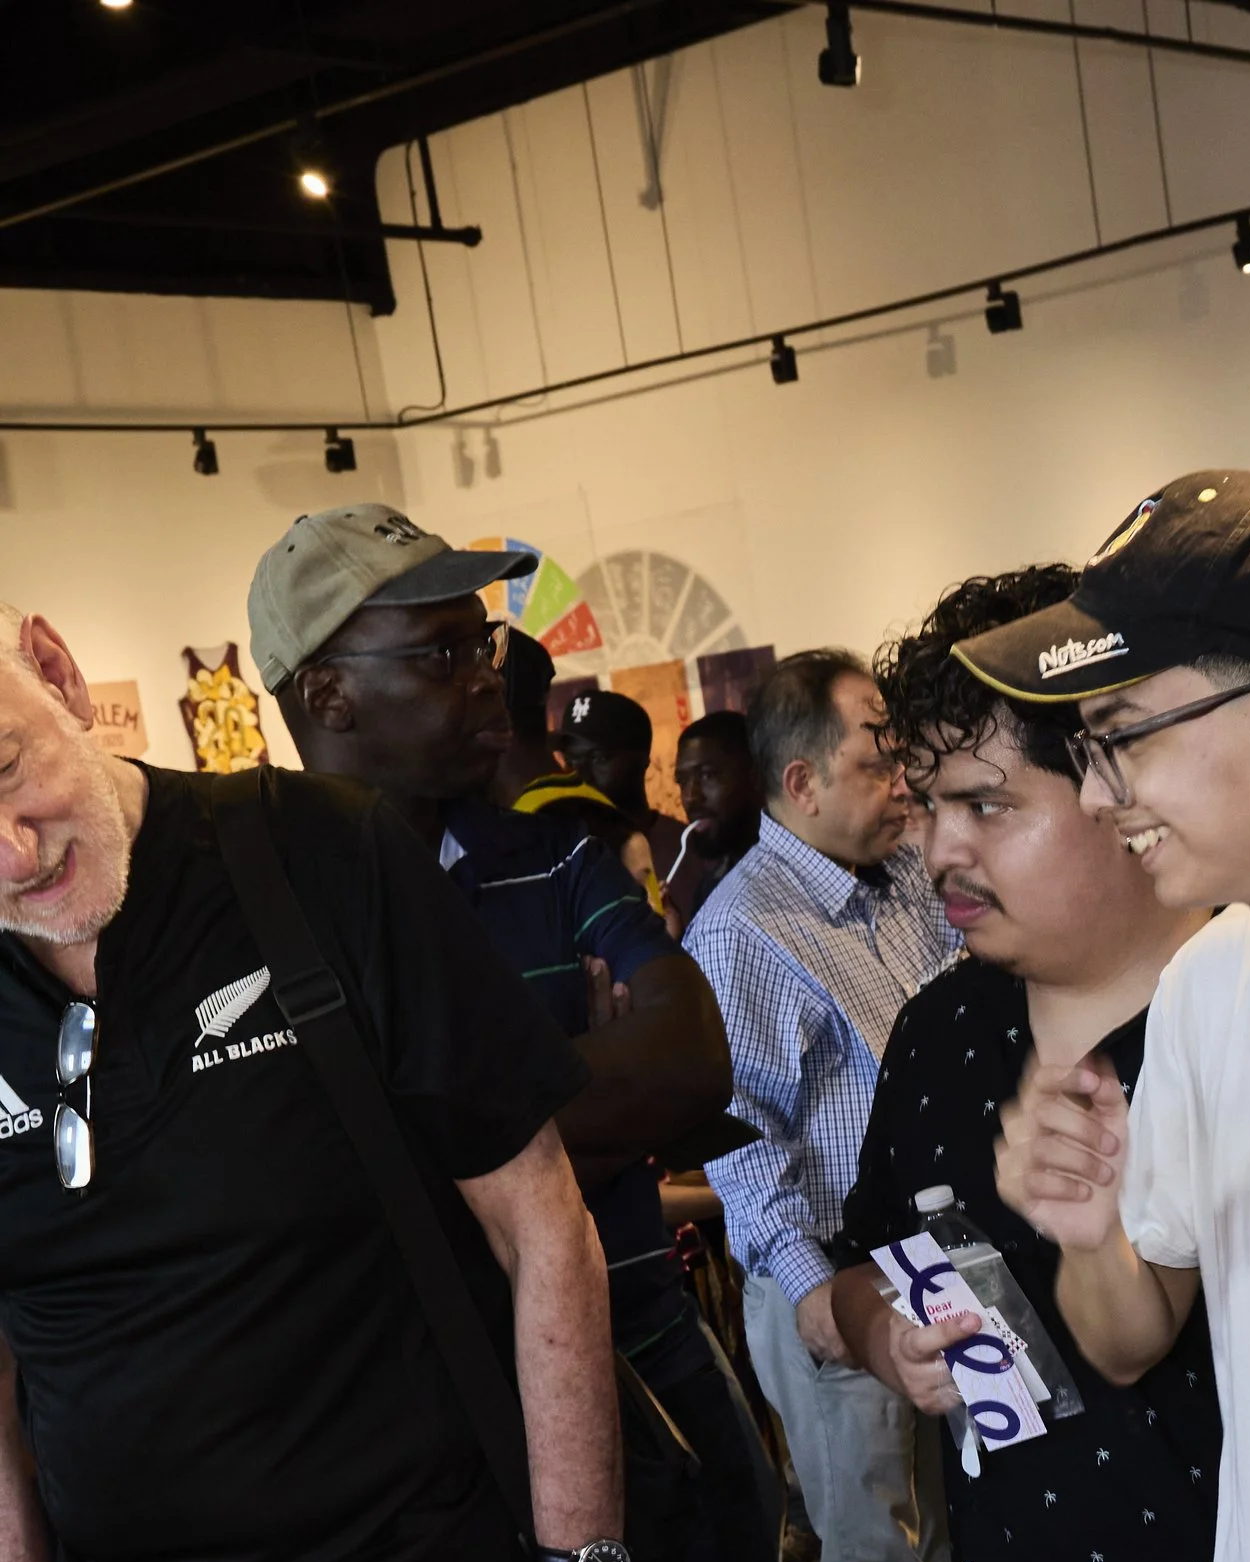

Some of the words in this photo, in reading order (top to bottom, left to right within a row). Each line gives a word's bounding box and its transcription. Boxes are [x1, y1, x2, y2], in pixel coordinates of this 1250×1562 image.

[92, 702, 139, 732] RLEM
[192, 1052, 223, 1073] ALL
[226, 1028, 298, 1061] BLACKS
[926, 1299, 953, 1316] Dear
